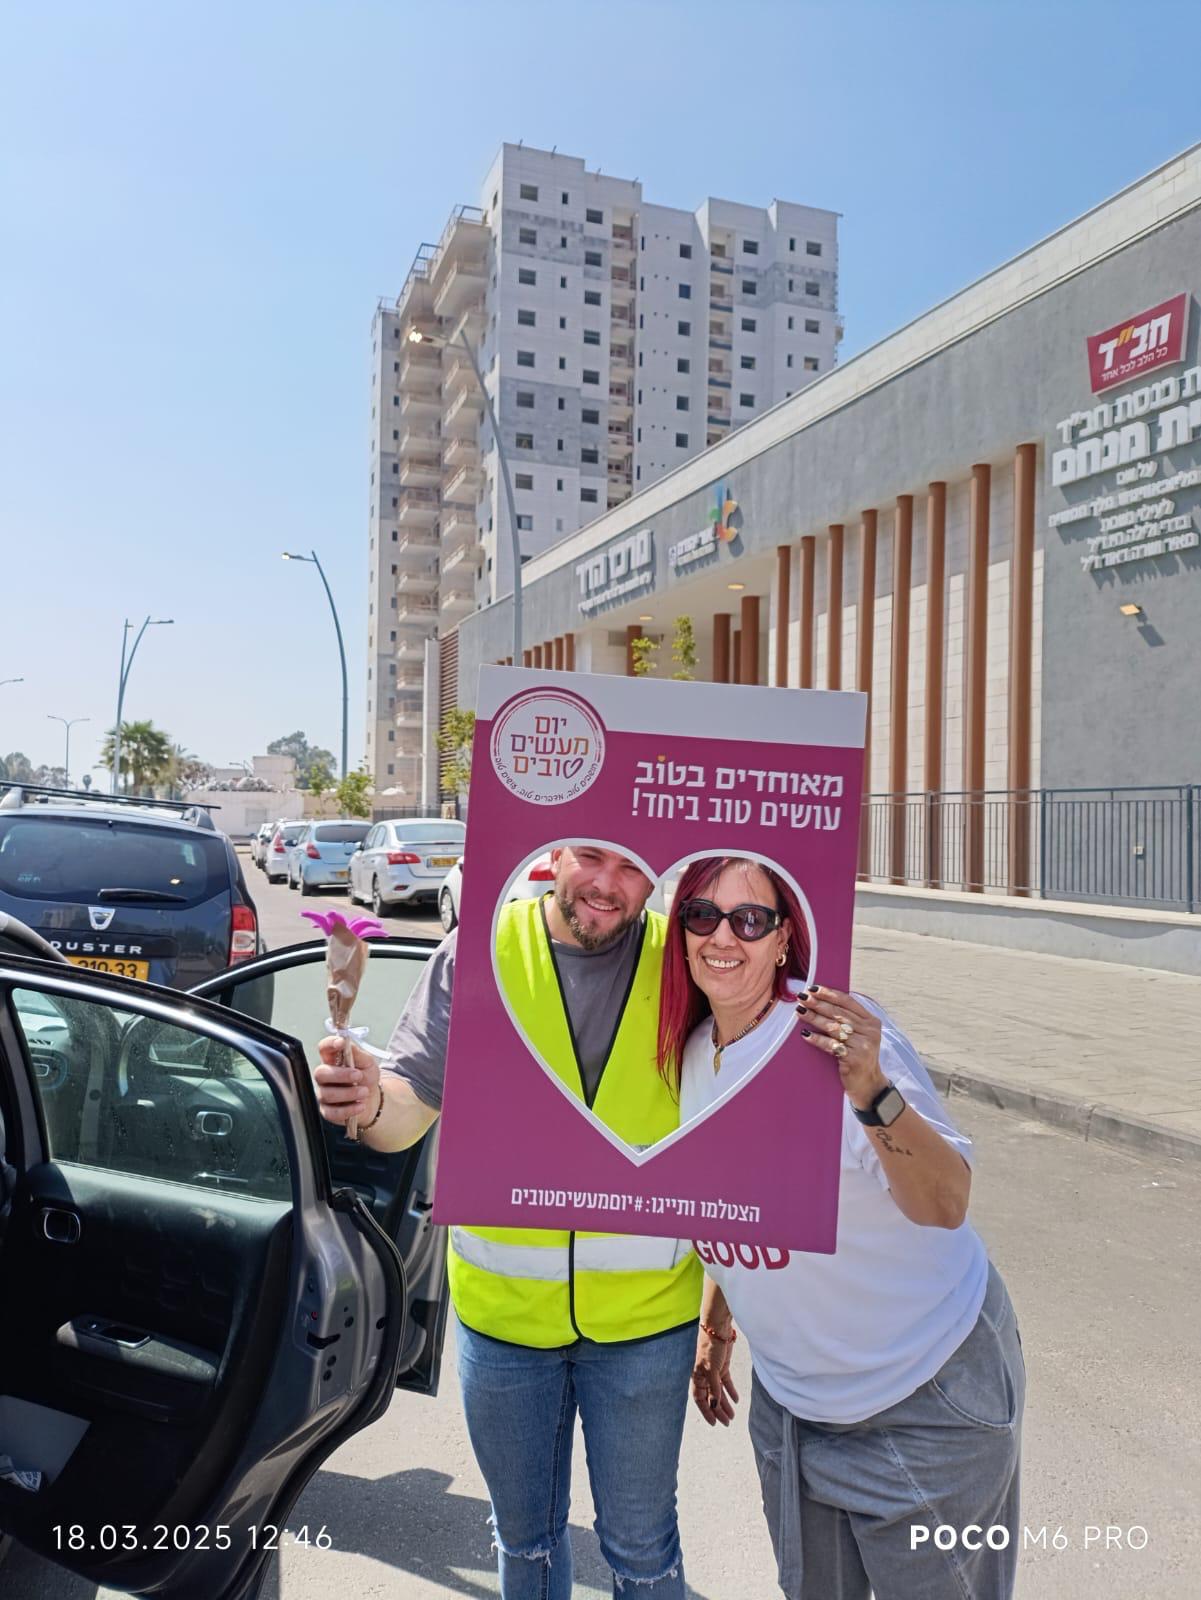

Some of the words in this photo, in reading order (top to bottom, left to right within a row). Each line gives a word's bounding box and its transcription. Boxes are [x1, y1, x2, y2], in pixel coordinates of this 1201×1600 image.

[1098, 313, 1171, 370] חב"ד
[1156, 347, 1168, 359] כל
[1120, 360, 1136, 374] לכל
[1137, 352, 1154, 367] הלב
[1115, 377, 1178, 424] כנסת
[1052, 421, 1150, 487] מנחם
[535, 716, 567, 735] יום
[511, 734, 589, 756] מעשים
[716, 767, 844, 798] מאוחדים
[631, 787, 700, 821] ביחד!
[707, 797, 752, 824] טוב
[759, 801, 841, 831] עושים
[50, 940, 142, 955] DUSTER
[700, 1198, 761, 1223] הצטלמו
[691, 1239, 790, 1270] GOOD
